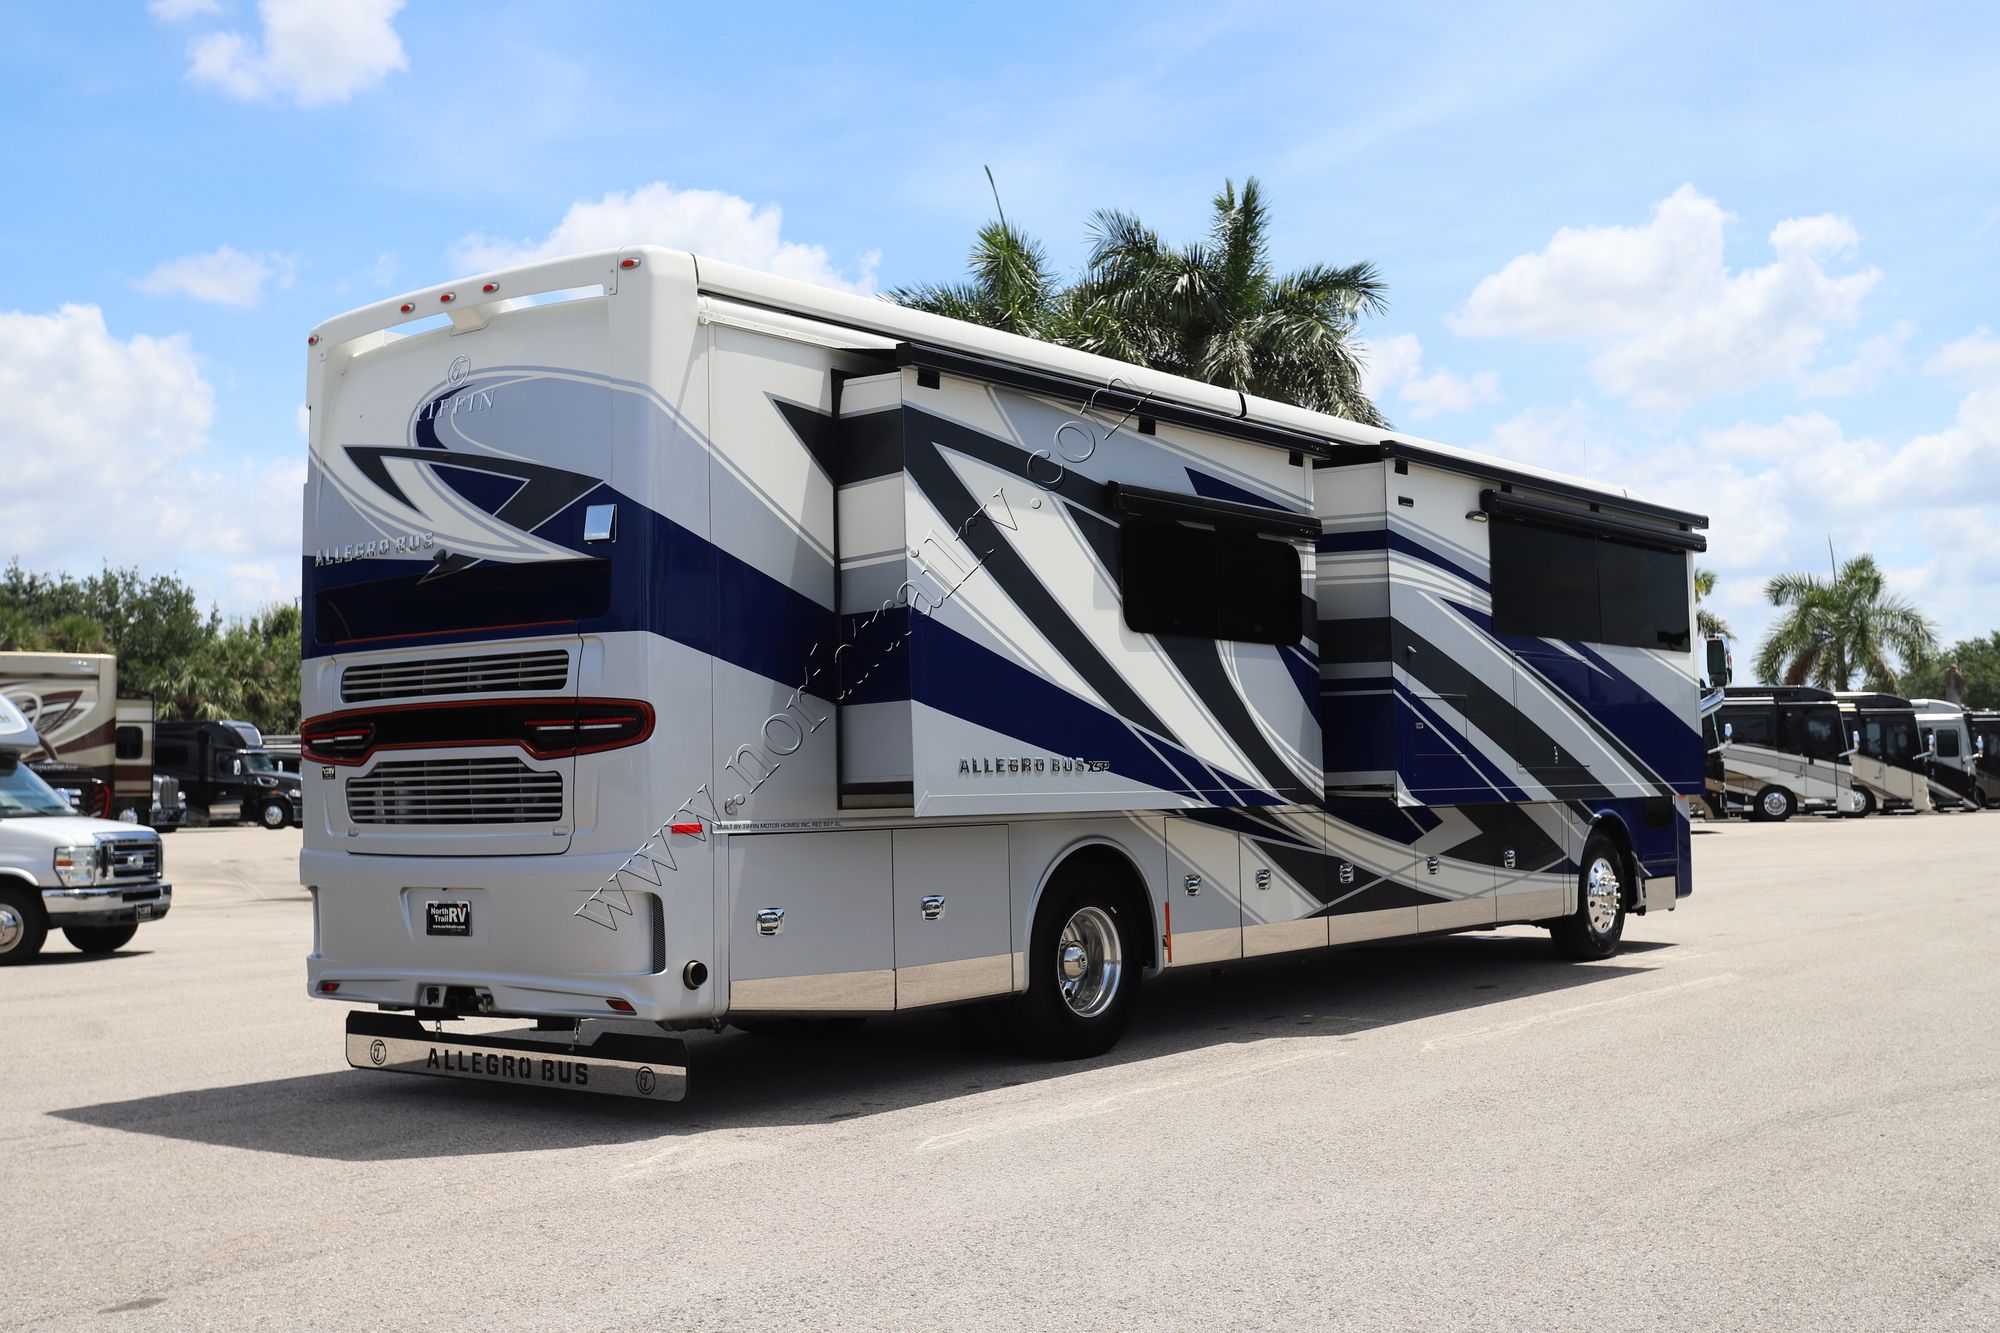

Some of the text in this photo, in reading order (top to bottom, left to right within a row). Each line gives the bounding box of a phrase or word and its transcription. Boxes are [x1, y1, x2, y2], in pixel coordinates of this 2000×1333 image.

[416, 390, 497, 422] TIFFIN
[315, 532, 435, 568] ALLEGRO BUS
[959, 757, 1110, 774] ALLEGRO BUS XSP
[743, 822, 760, 830] TIFFIN
[430, 907, 449, 915] North
[434, 914, 449, 922] Trail
[449, 907, 467, 923] RV
[426, 1047, 589, 1085] ALLEGRO BUS
